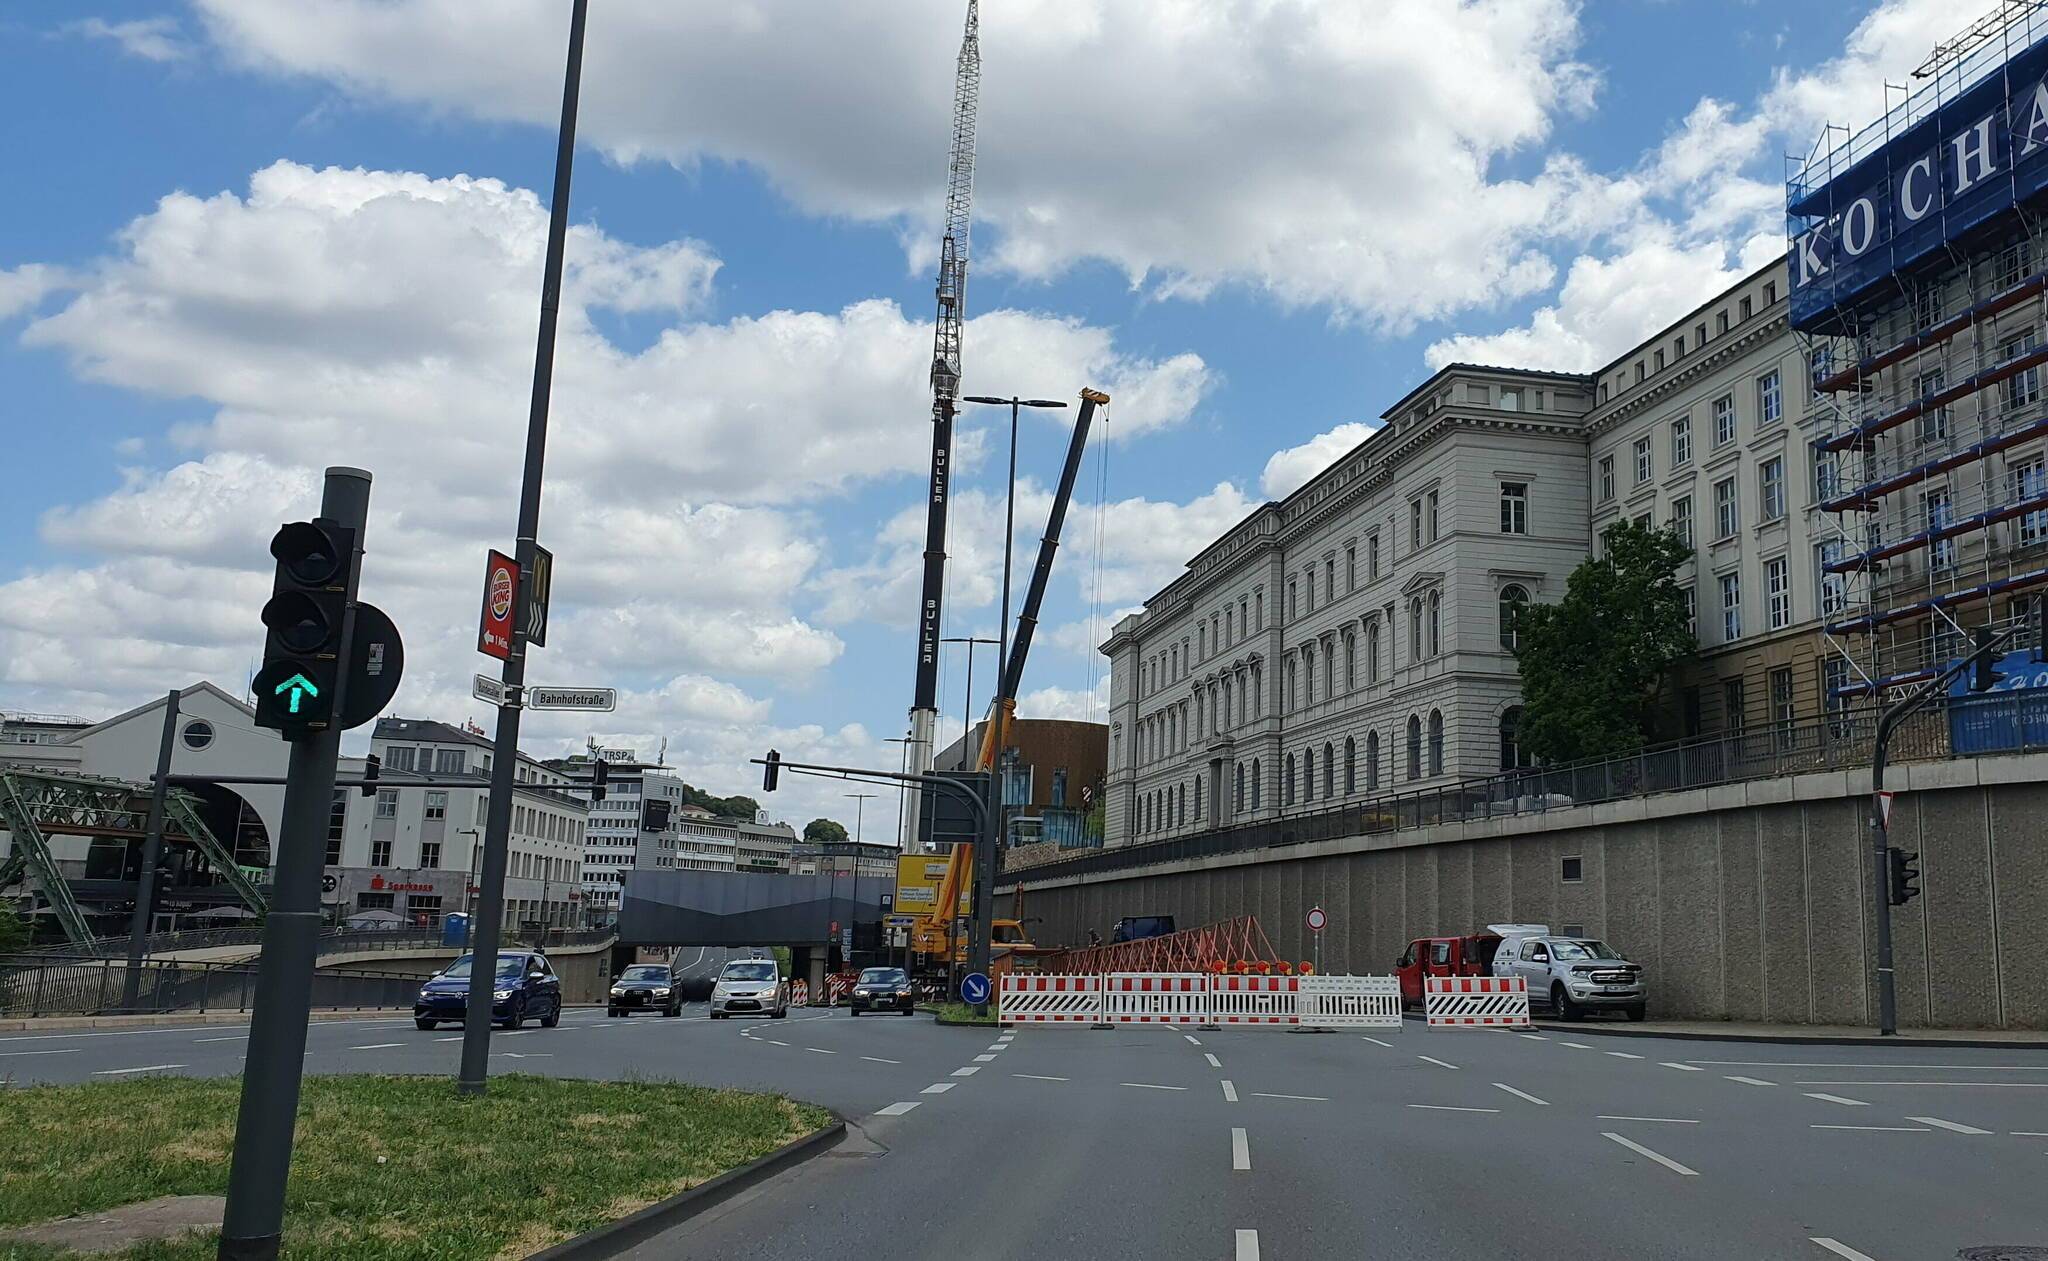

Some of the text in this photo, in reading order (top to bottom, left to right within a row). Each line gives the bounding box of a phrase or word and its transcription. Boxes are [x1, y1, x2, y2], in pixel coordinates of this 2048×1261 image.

[934, 449, 945, 503] BULLER
[493, 580, 510, 592] BURGER
[491, 589, 510, 605] KING
[923, 599, 936, 664] BULLER
[540, 692, 605, 706] Bahnhofstraße
[388, 881, 433, 893] Sparkasse
